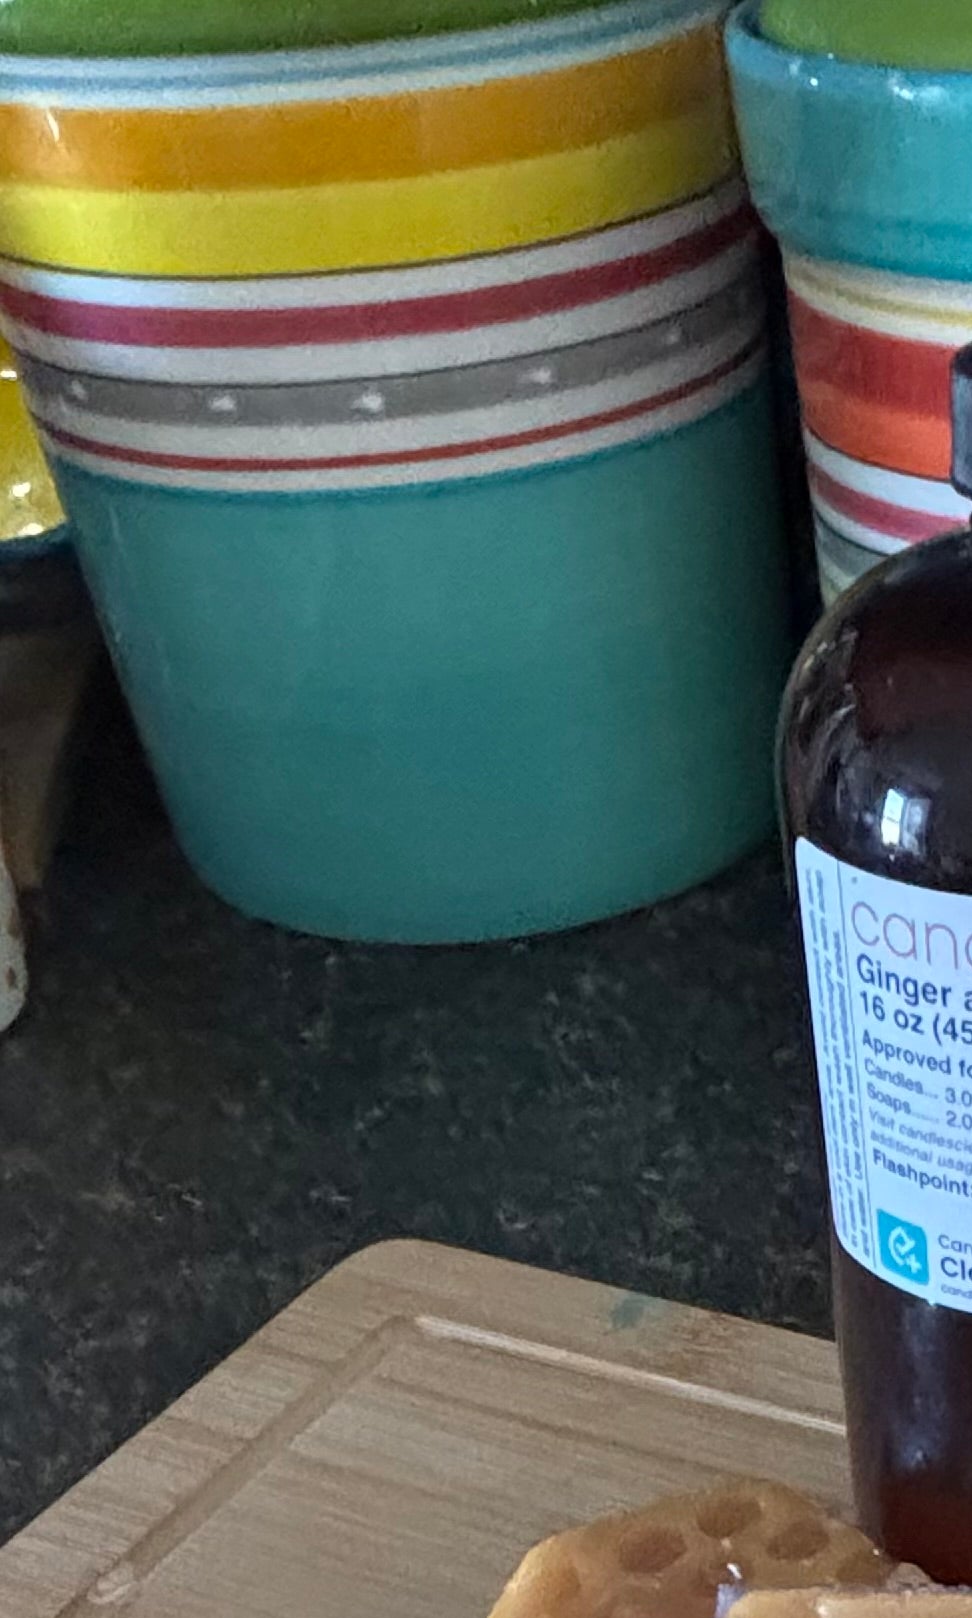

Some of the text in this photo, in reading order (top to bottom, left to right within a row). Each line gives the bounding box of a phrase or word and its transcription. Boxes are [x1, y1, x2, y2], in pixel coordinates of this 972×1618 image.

[856, 952, 952, 1008] Ginger
[859, 990, 886, 1022] 16
[893, 1008, 925, 1036] oz
[861, 1028, 952, 1076] Approved
